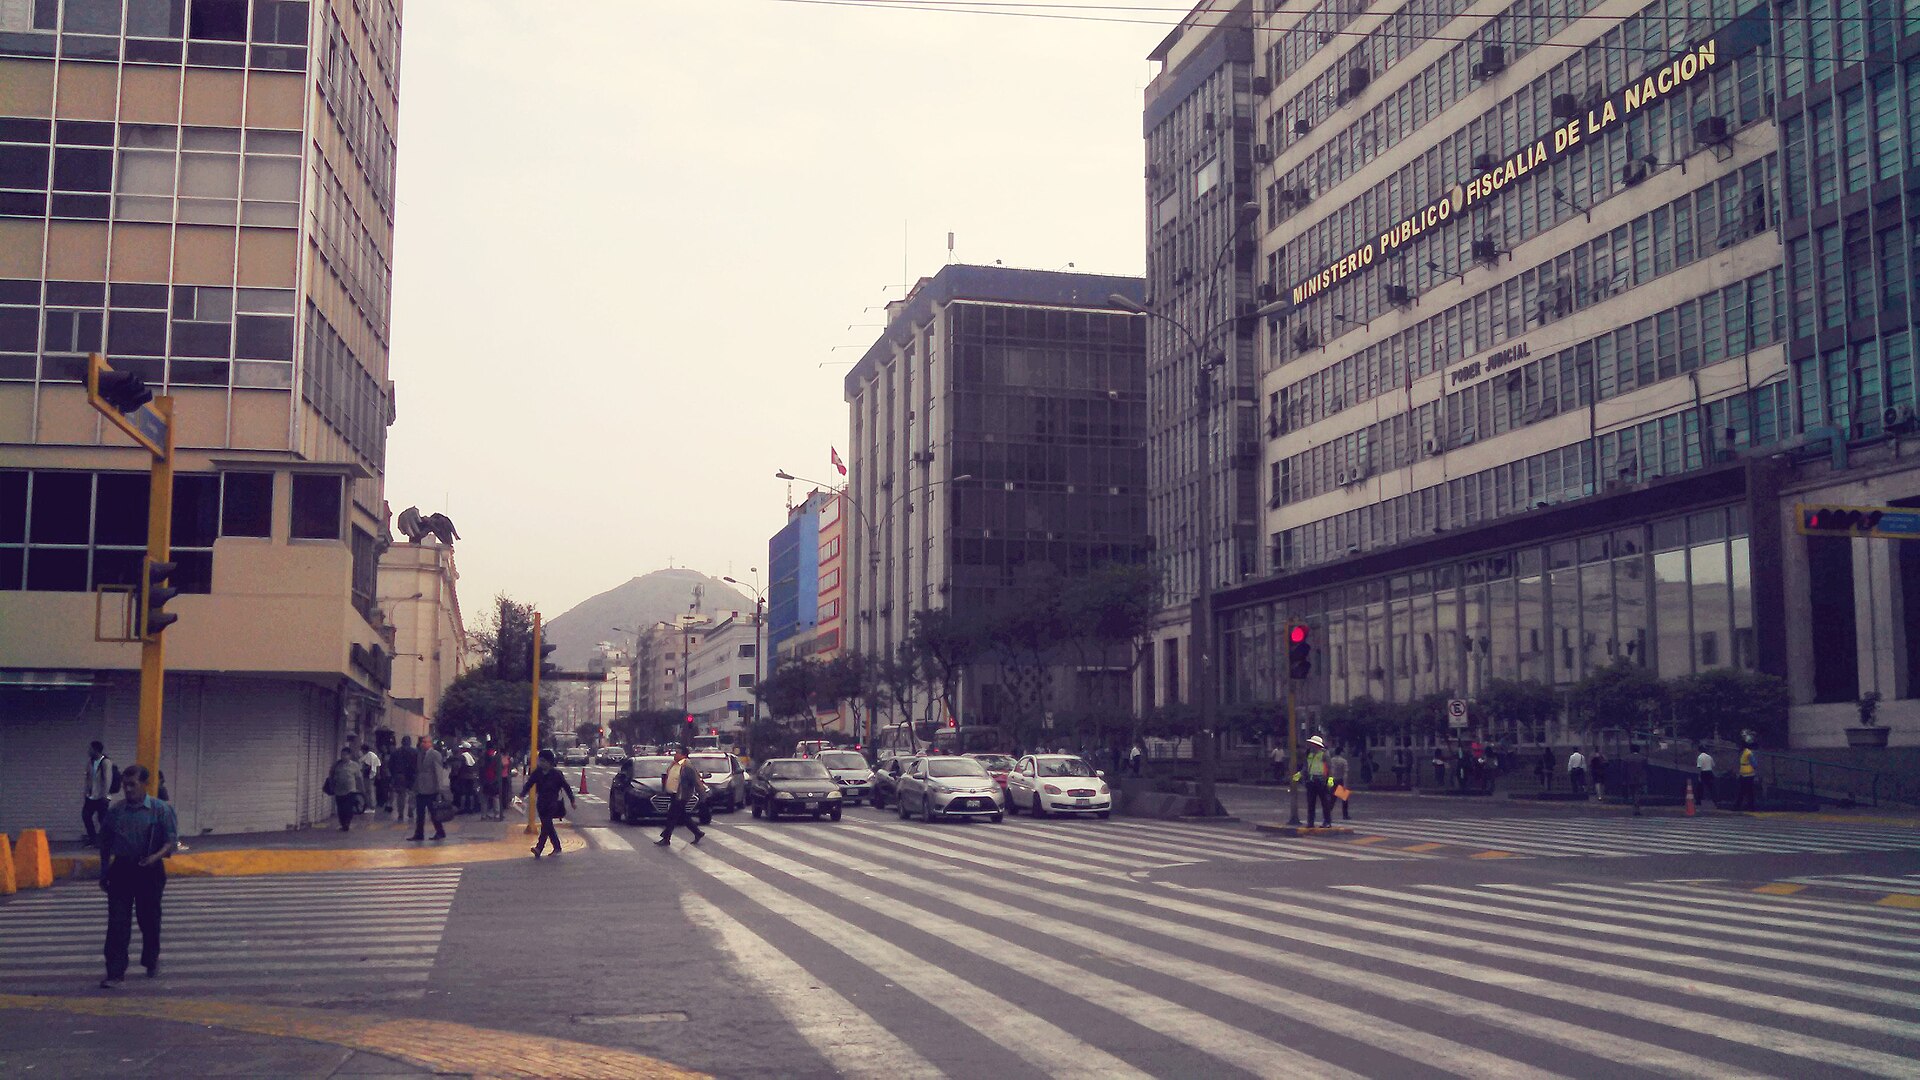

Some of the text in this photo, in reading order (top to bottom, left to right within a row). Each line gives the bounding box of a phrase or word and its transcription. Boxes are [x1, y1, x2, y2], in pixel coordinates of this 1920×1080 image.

[1293, 244, 1373, 305] MINISTERIO
[1554, 119, 1580, 154] DE
[1588, 100, 1616, 135] LA
[1451, 341, 1531, 387] PODER JUDICIAL
